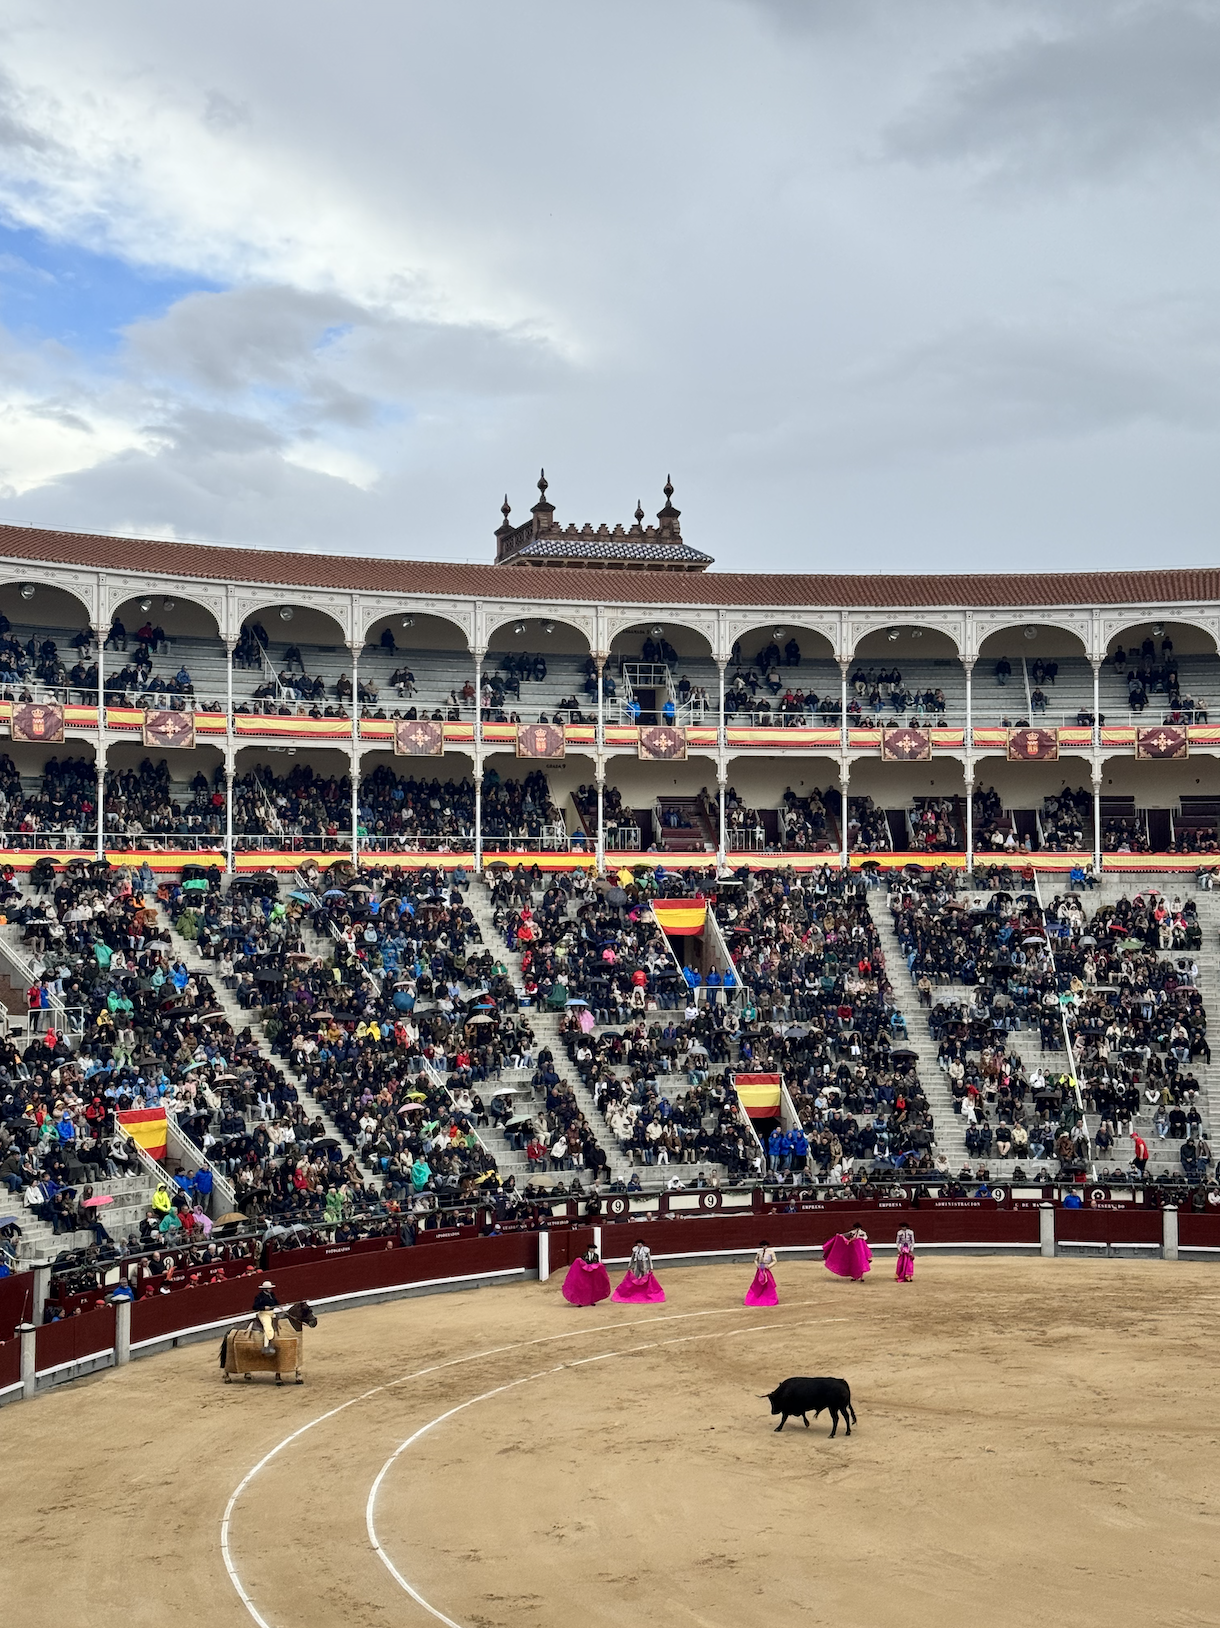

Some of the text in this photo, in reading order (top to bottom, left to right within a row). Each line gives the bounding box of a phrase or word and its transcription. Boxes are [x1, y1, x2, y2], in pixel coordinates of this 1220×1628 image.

[995, 1189, 1002, 1200] 9
[615, 1200, 621, 1211] 9
[708, 1195, 714, 1206] 9
